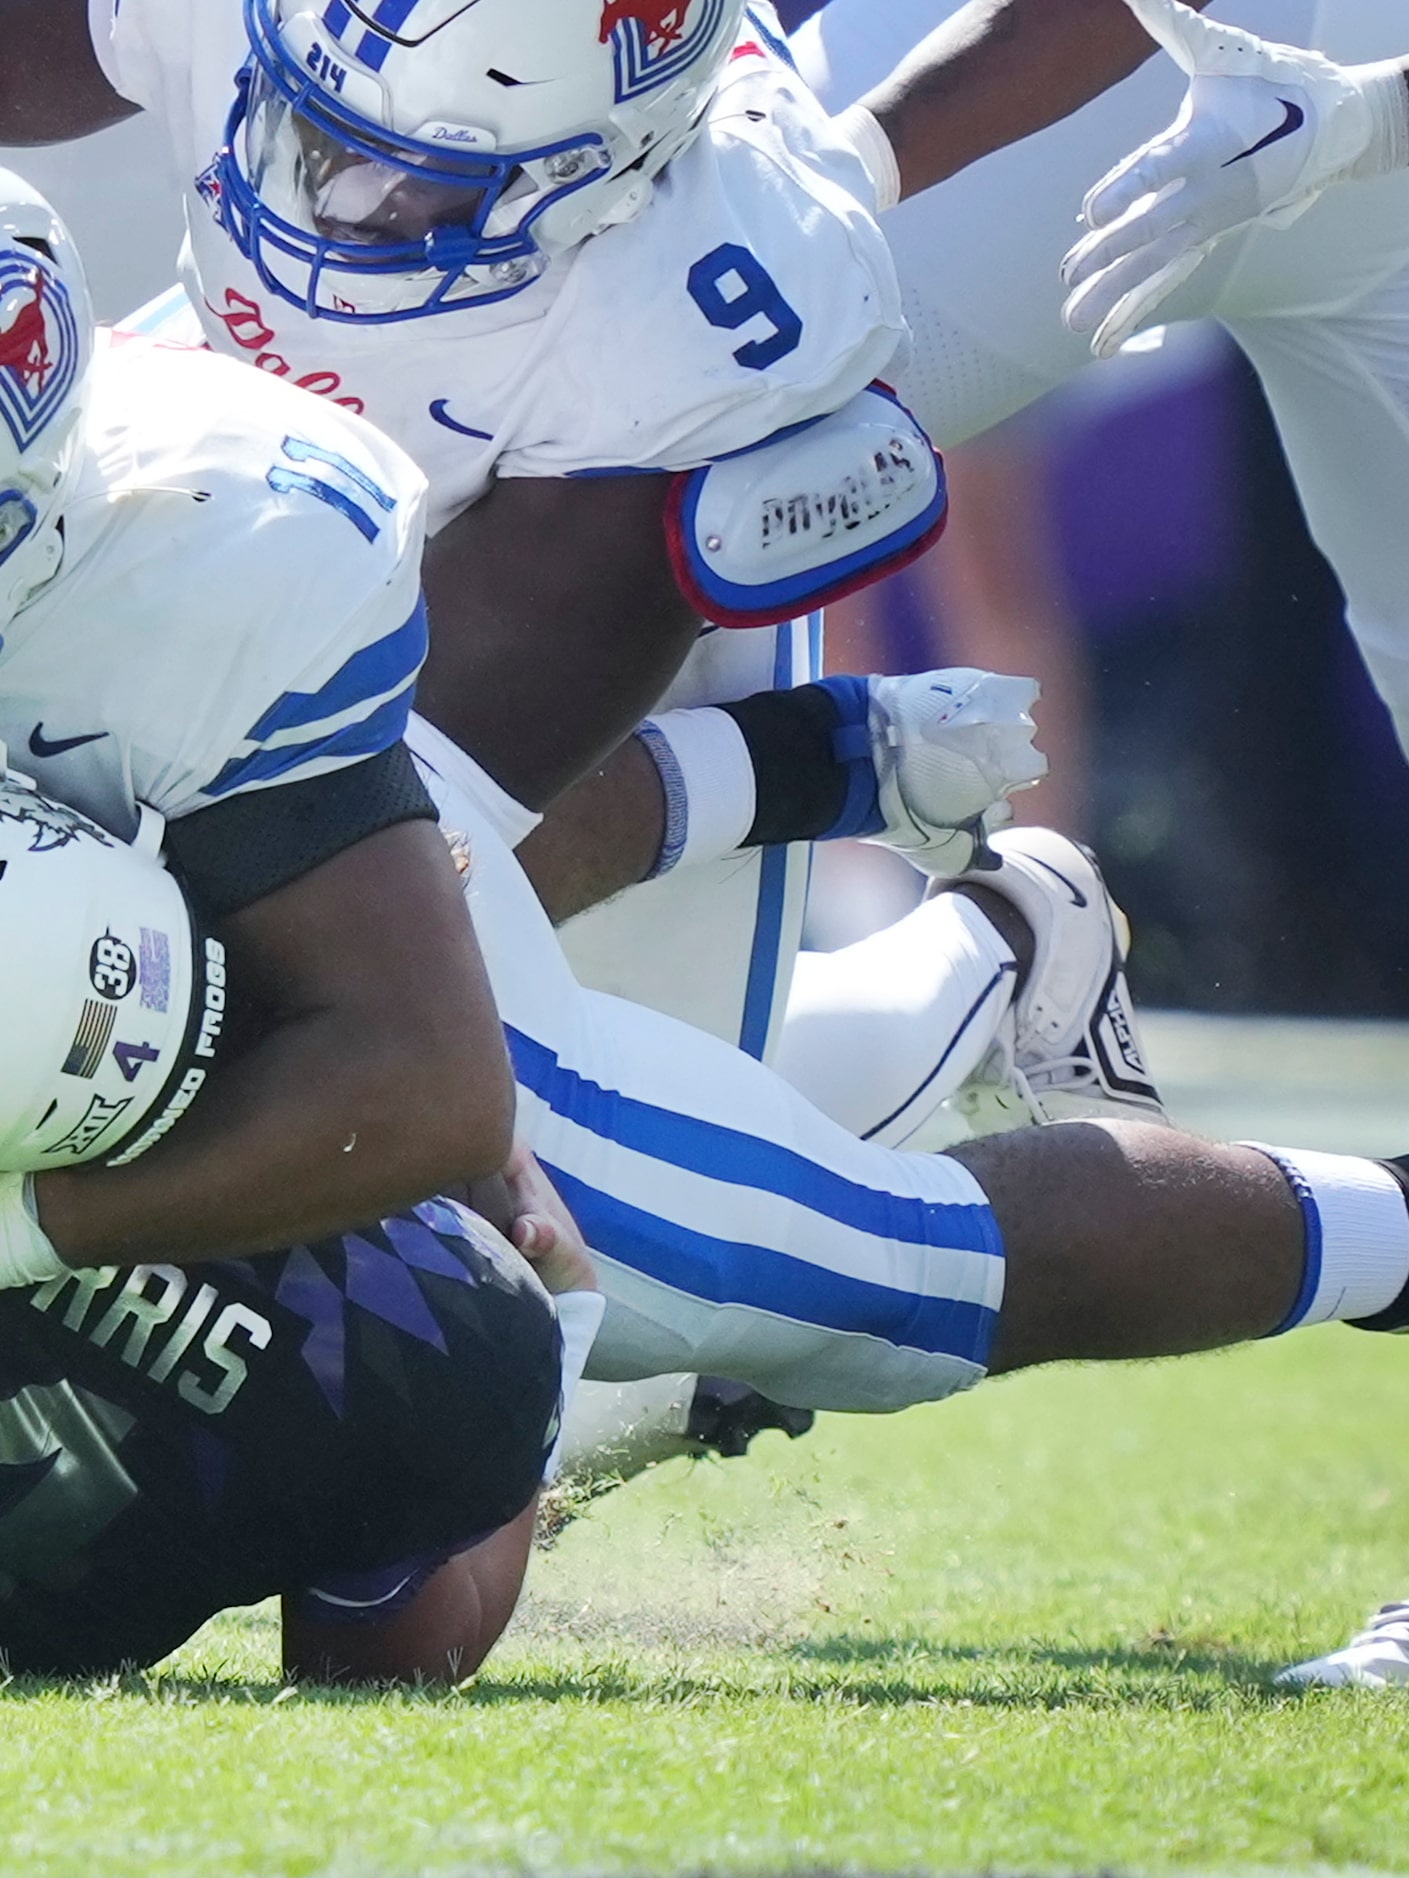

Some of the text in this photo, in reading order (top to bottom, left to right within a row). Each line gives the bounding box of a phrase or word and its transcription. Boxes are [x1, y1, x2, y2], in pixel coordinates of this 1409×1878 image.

[305, 42, 347, 93] 214
[431, 126, 478, 143] Dallas
[686, 242, 803, 371] 9
[265, 434, 397, 545] 11
[93, 938, 131, 997] 38
[195, 937, 226, 1058] FROGS
[112, 1041, 160, 1082] 4
